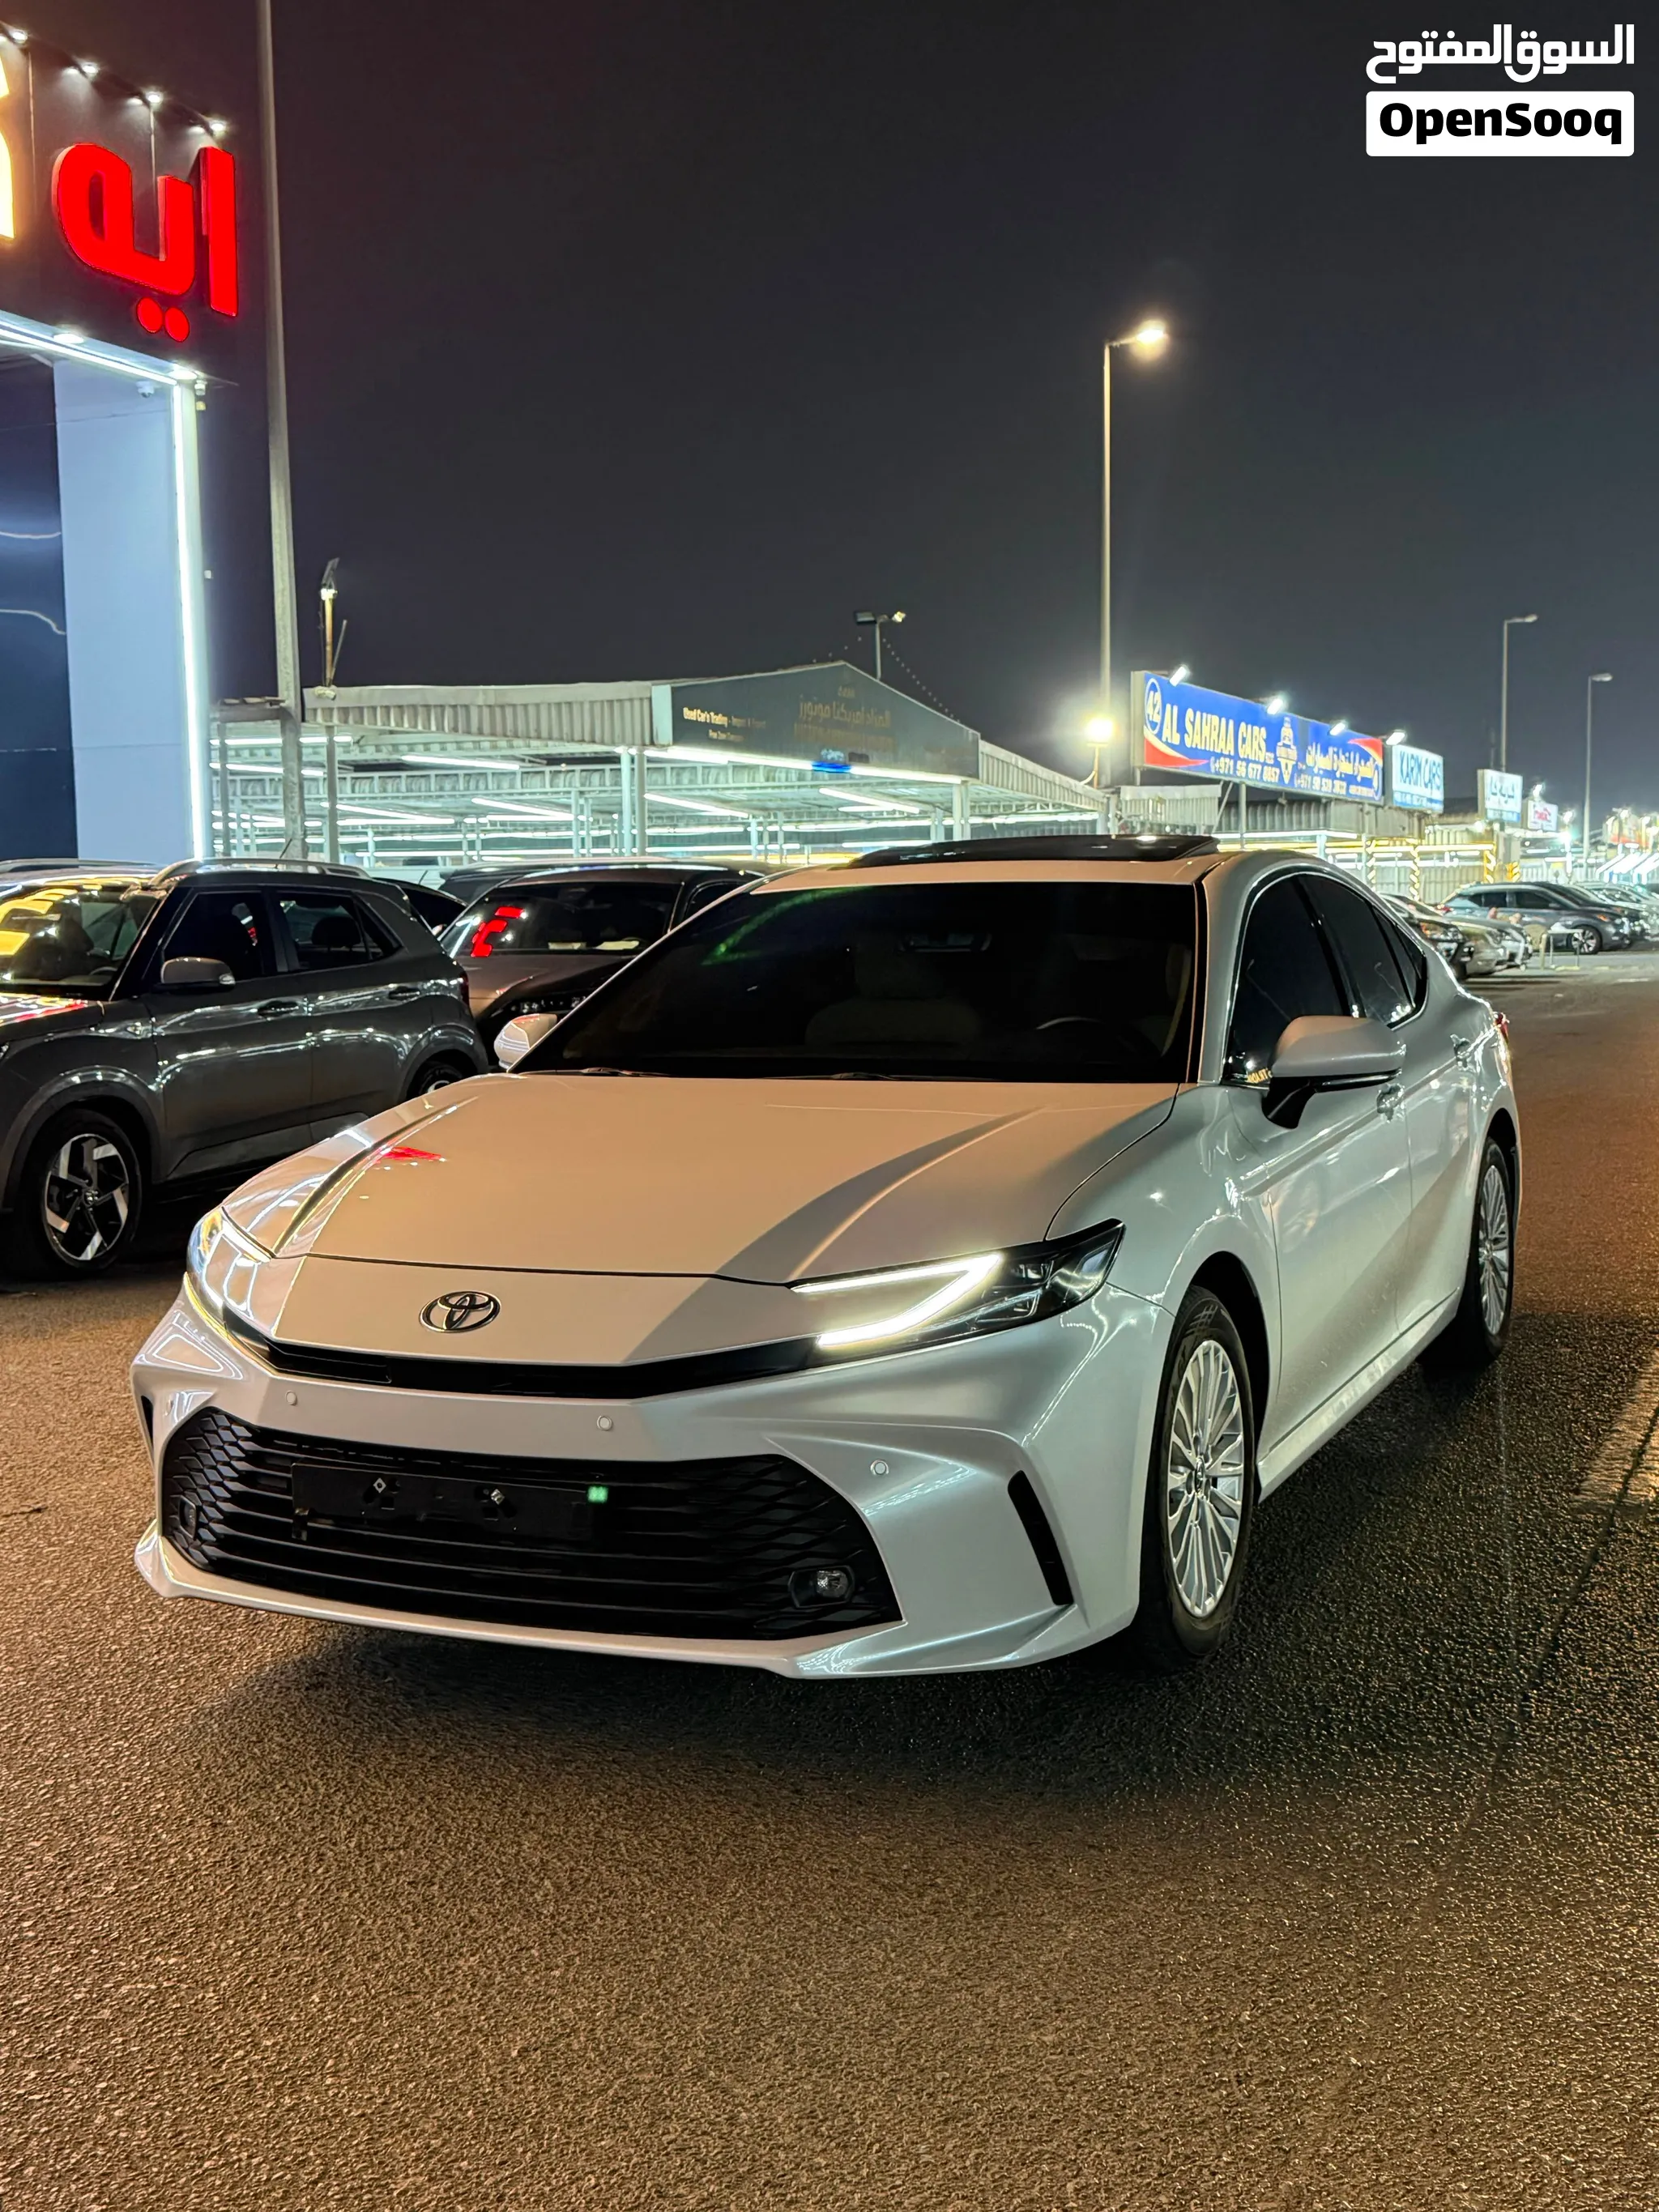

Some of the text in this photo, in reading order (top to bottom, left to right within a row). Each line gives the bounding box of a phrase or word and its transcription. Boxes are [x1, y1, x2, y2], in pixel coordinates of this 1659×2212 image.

[1146, 690, 1162, 722] 42
[1162, 703, 1267, 763] AL SAHRAA CARS
